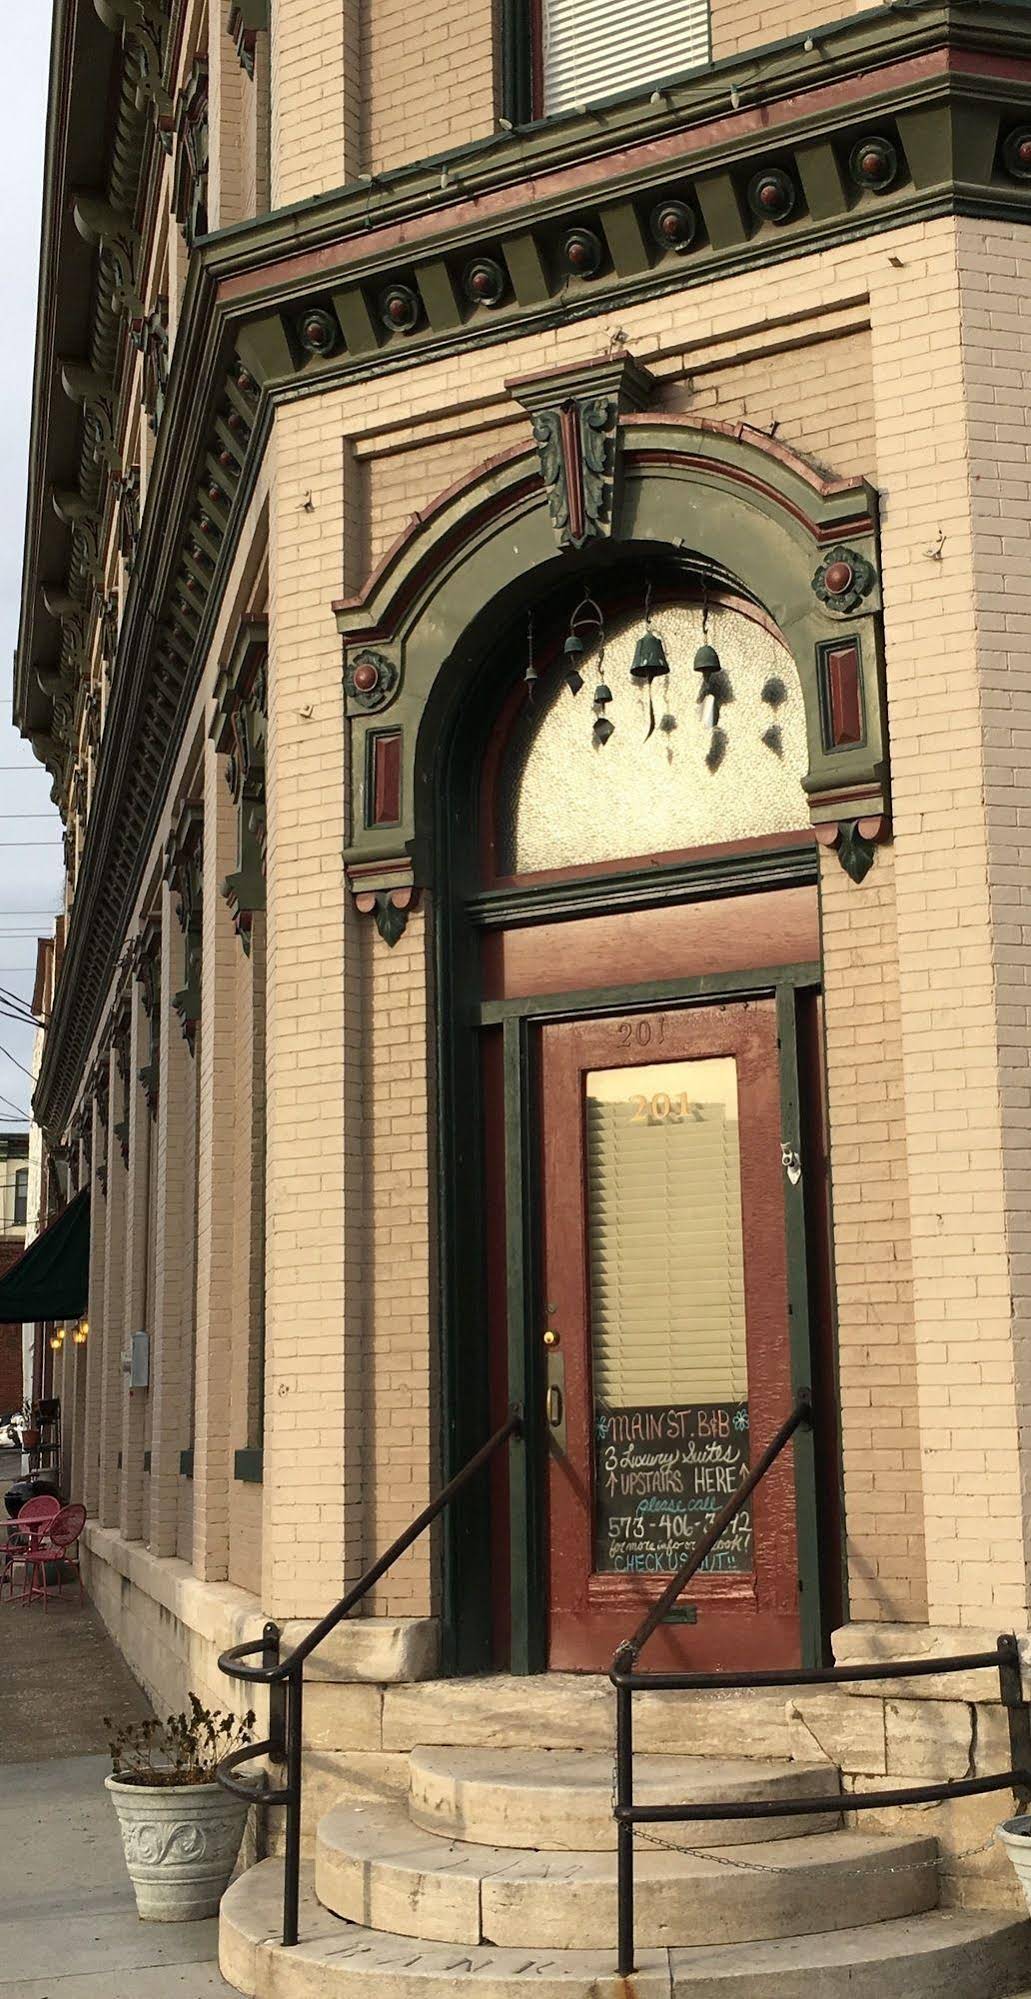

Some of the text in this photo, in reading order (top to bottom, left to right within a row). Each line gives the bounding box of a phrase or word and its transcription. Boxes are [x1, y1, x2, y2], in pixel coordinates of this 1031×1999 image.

[617, 1017, 665, 1048] 201
[630, 1091, 691, 1121] 201
[608, 1412, 665, 1441] MAIN
[667, 1409, 695, 1438] ST.
[605, 1441, 740, 1473] 3 Luxury Suites
[621, 1466, 737, 1495] UPSTAIRS HERE
[636, 1496, 723, 1517] please call
[608, 1534, 751, 1558] for more info or ook!
[614, 1552, 665, 1572] CHECK
